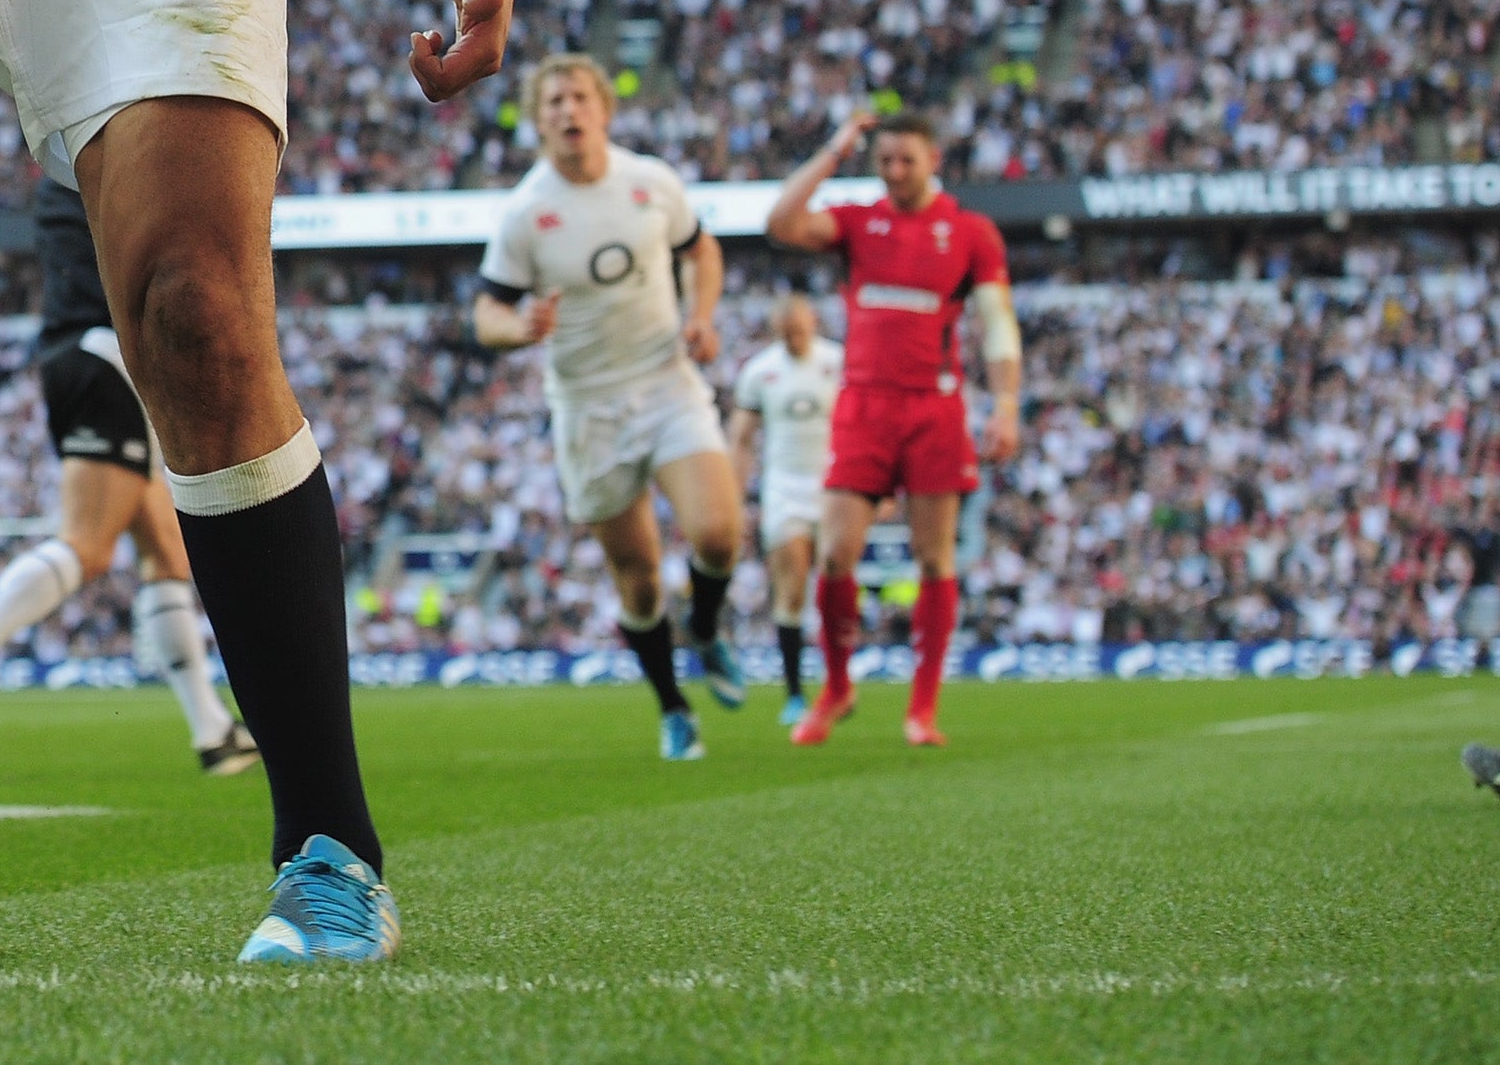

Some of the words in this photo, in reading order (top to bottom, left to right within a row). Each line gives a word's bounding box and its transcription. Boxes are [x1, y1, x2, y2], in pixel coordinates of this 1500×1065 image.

[1200, 169, 1298, 215] WILL
[1300, 166, 1341, 212] IT
[1346, 164, 1446, 211] TAKE
[1449, 162, 1500, 208] TO
